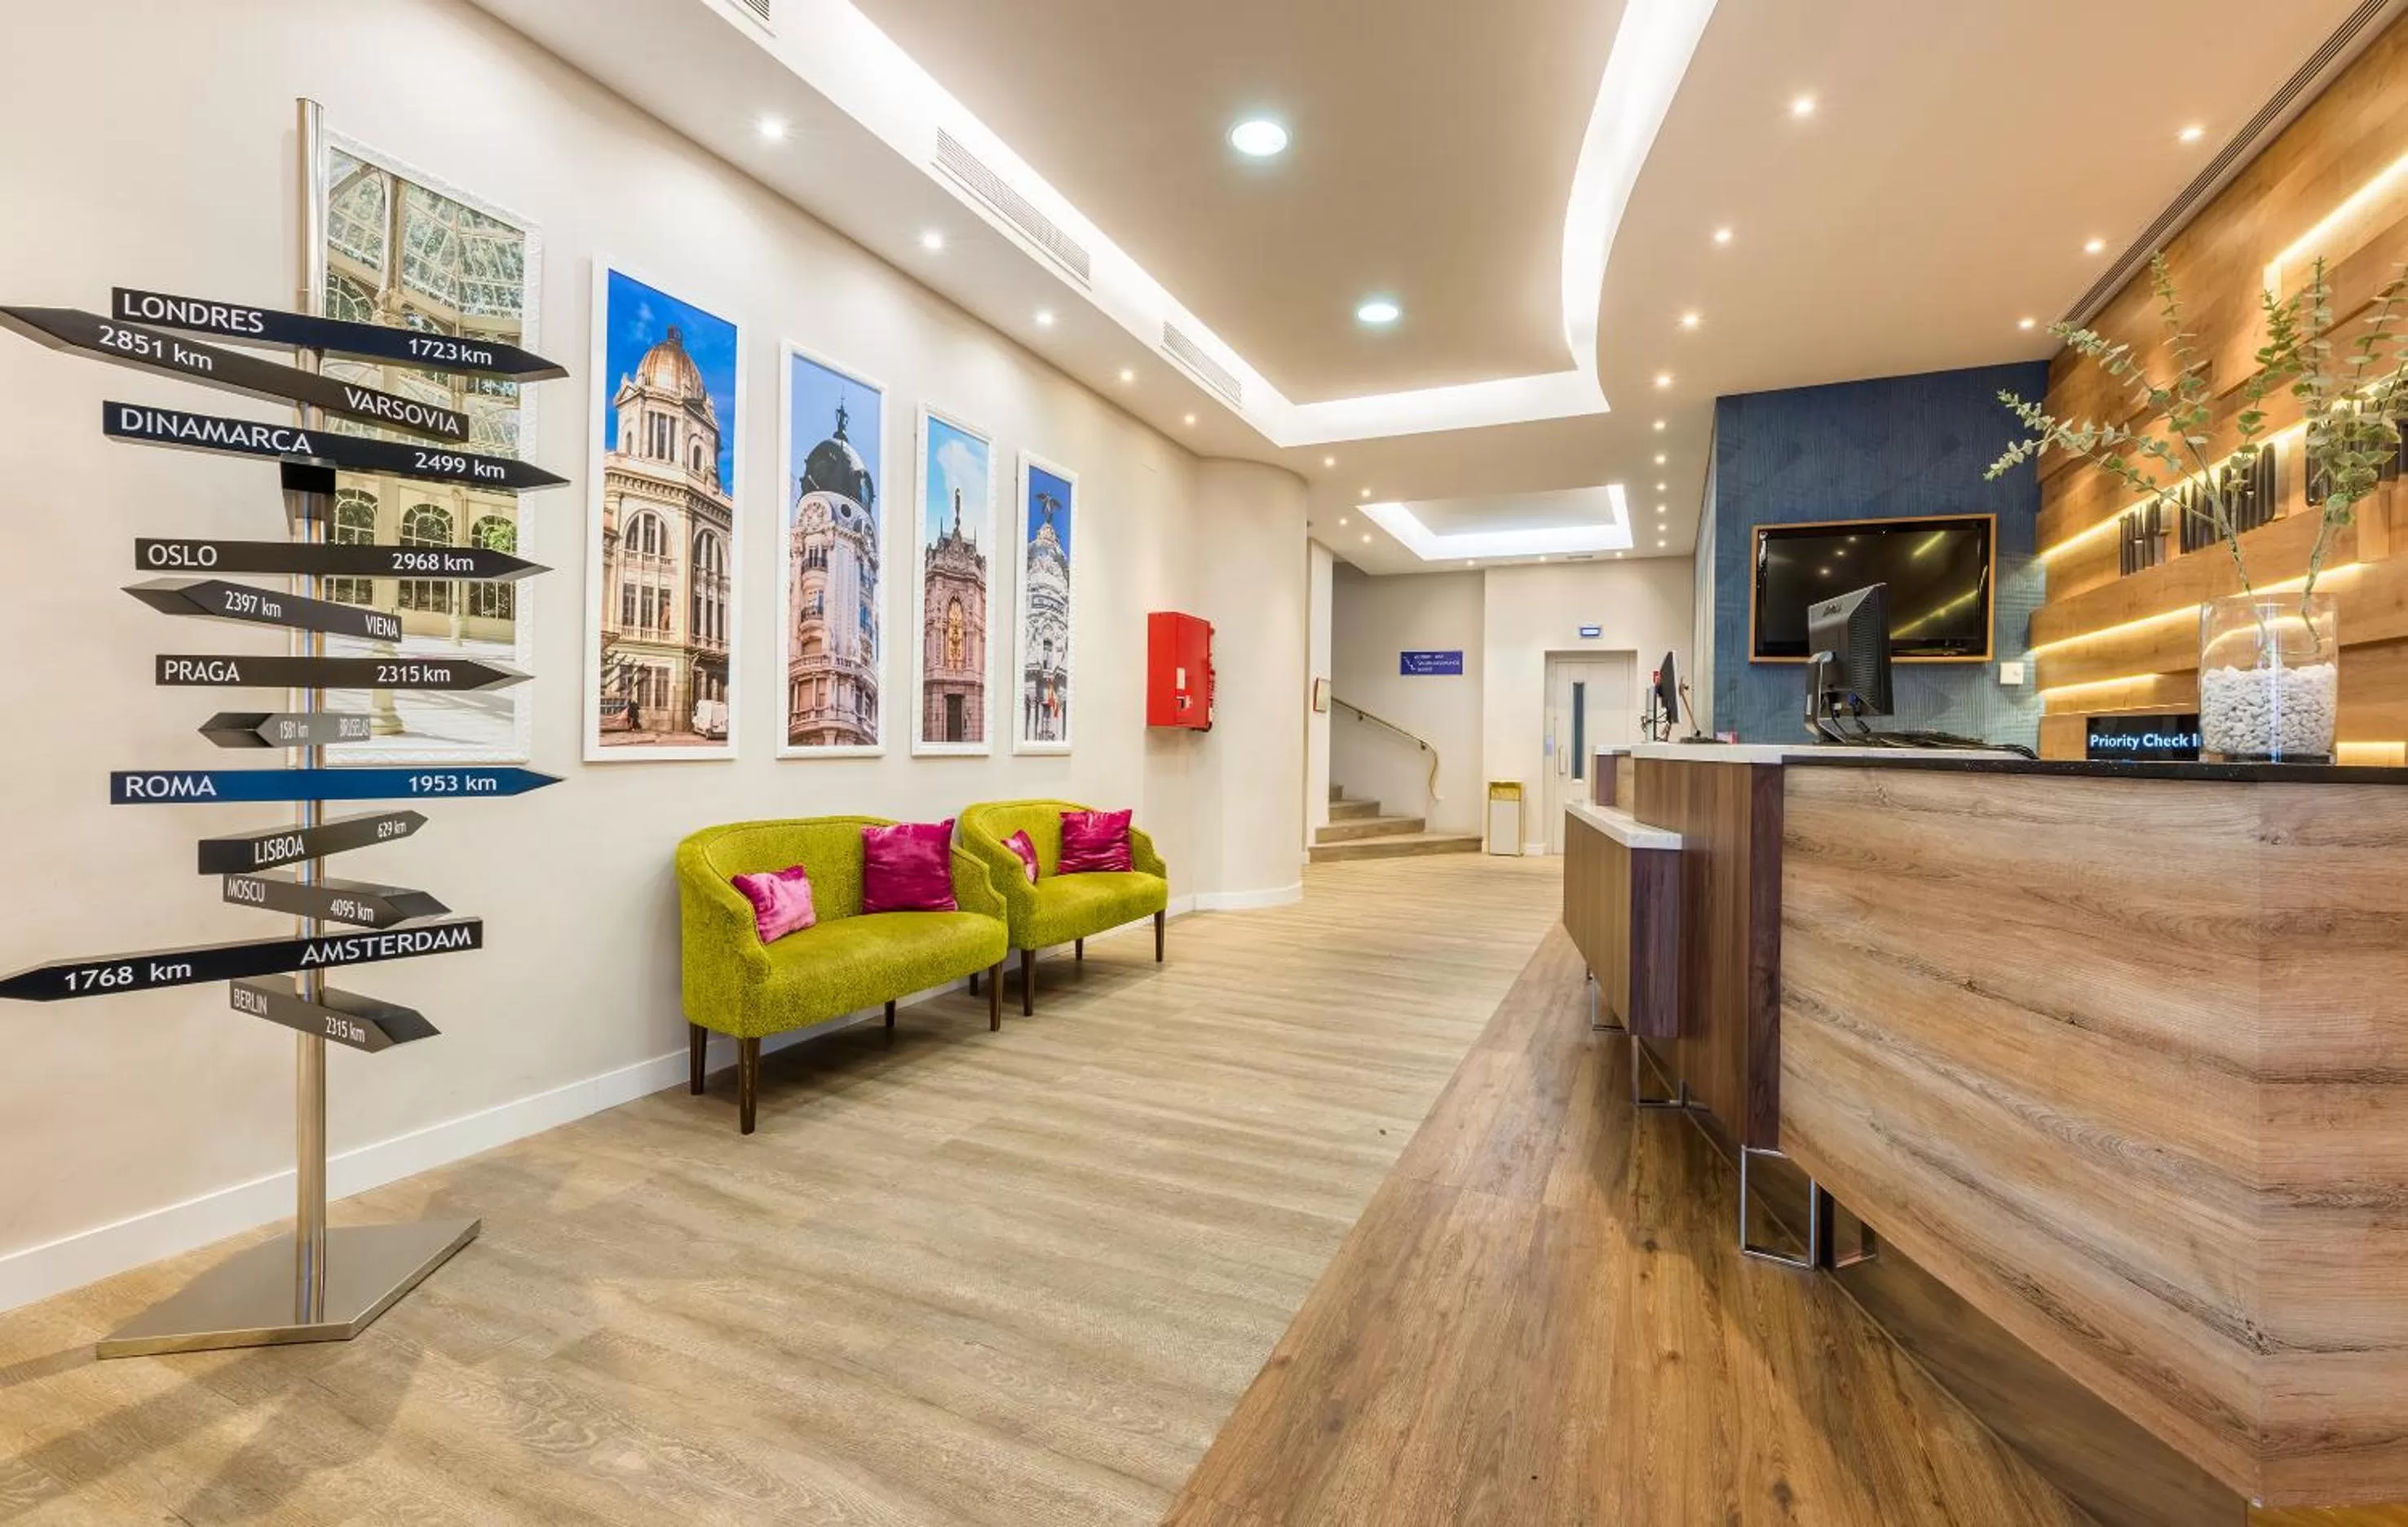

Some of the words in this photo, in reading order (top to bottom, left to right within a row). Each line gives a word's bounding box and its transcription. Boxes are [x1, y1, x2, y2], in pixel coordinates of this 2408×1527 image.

[124, 293, 264, 333] LONDRES
[409, 339, 457, 361] 1723
[461, 344, 493, 365] km
[99, 325, 162, 359] 2851
[174, 343, 213, 371] km
[344, 387, 460, 435] VARSOVIA
[122, 408, 312, 454] DINAMARCA
[414, 452, 466, 473] 2499
[474, 459, 505, 479] km
[148, 544, 218, 566] OSLO
[392, 553, 439, 570] 2968
[444, 553, 474, 571] km
[225, 591, 258, 613] 2397
[262, 596, 281, 617] km
[365, 614, 398, 638] VIENA
[165, 660, 240, 682] PRAGA
[377, 666, 420, 682] 2315
[423, 664, 450, 682] km
[298, 720, 309, 738] km
[2090, 734, 2140, 750] Priority
[2142, 733, 2189, 747] Check
[126, 775, 217, 797] ROMA
[409, 775, 458, 792] 1953
[466, 775, 497, 790] km
[254, 834, 305, 864] LISBOA
[378, 821, 392, 839] 629
[394, 820, 407, 834] km
[228, 878, 265, 902] MOSCU
[330, 898, 356, 918] 4095
[358, 901, 374, 922] km
[65, 966, 134, 990] 1768
[150, 963, 192, 981] km
[300, 927, 472, 965] AMSTERDAM
[233, 989, 267, 1015] BERLIN
[325, 1016, 348, 1038] 2315
[349, 1020, 365, 1043] km
